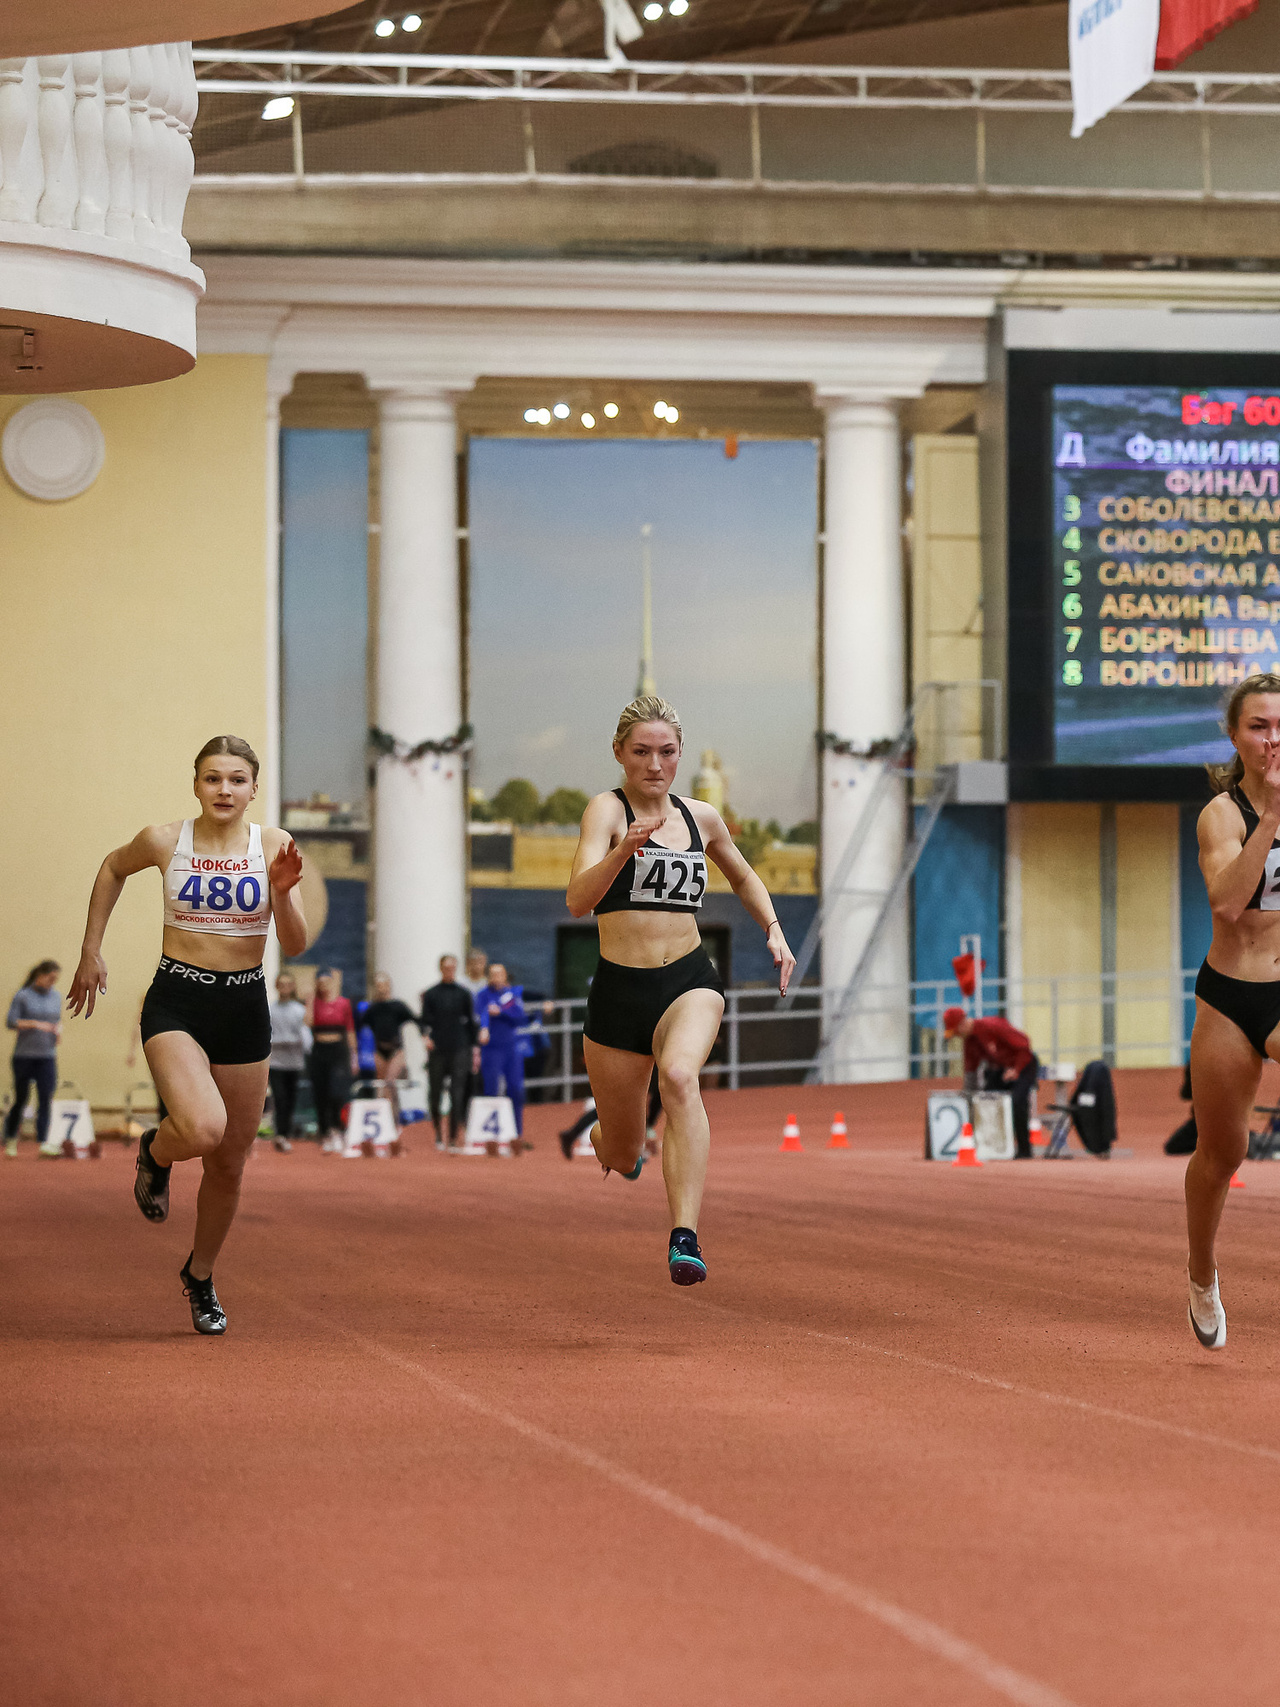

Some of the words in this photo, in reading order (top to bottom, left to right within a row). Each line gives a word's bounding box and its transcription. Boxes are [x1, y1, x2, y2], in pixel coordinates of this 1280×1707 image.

[1056, 432, 1087, 468] Д
[1125, 431, 1280, 464] Фамилия
[1165, 468, 1279, 497] ФИНАЛ
[1063, 495, 1082, 522] 3
[1062, 526, 1082, 552] 4
[1098, 528, 1263, 557] СКОВОРОДА
[1062, 559, 1082, 586] 5
[1098, 561, 1257, 587] САКОВСКАЯ
[1062, 593, 1083, 619] 6
[1098, 594, 1232, 619] АБАХИНА
[1063, 626, 1083, 653] 7
[1099, 627, 1278, 654] БОБРЫШЕВА
[1062, 659, 1084, 686] 8
[1100, 660, 1266, 687] ВОРОШИНА
[191, 857, 249, 872] ЦФКСиЗ
[178, 875, 261, 913] 480
[641, 859, 705, 903] 425
[174, 914, 230, 924] МОСКОВСКОГО
[169, 963, 217, 984] PRO
[226, 967, 264, 986] NIKE
[63, 1112, 79, 1139] 7
[363, 1111, 381, 1139] 5
[482, 1110, 500, 1135] 4
[935, 1105, 964, 1156] 2
